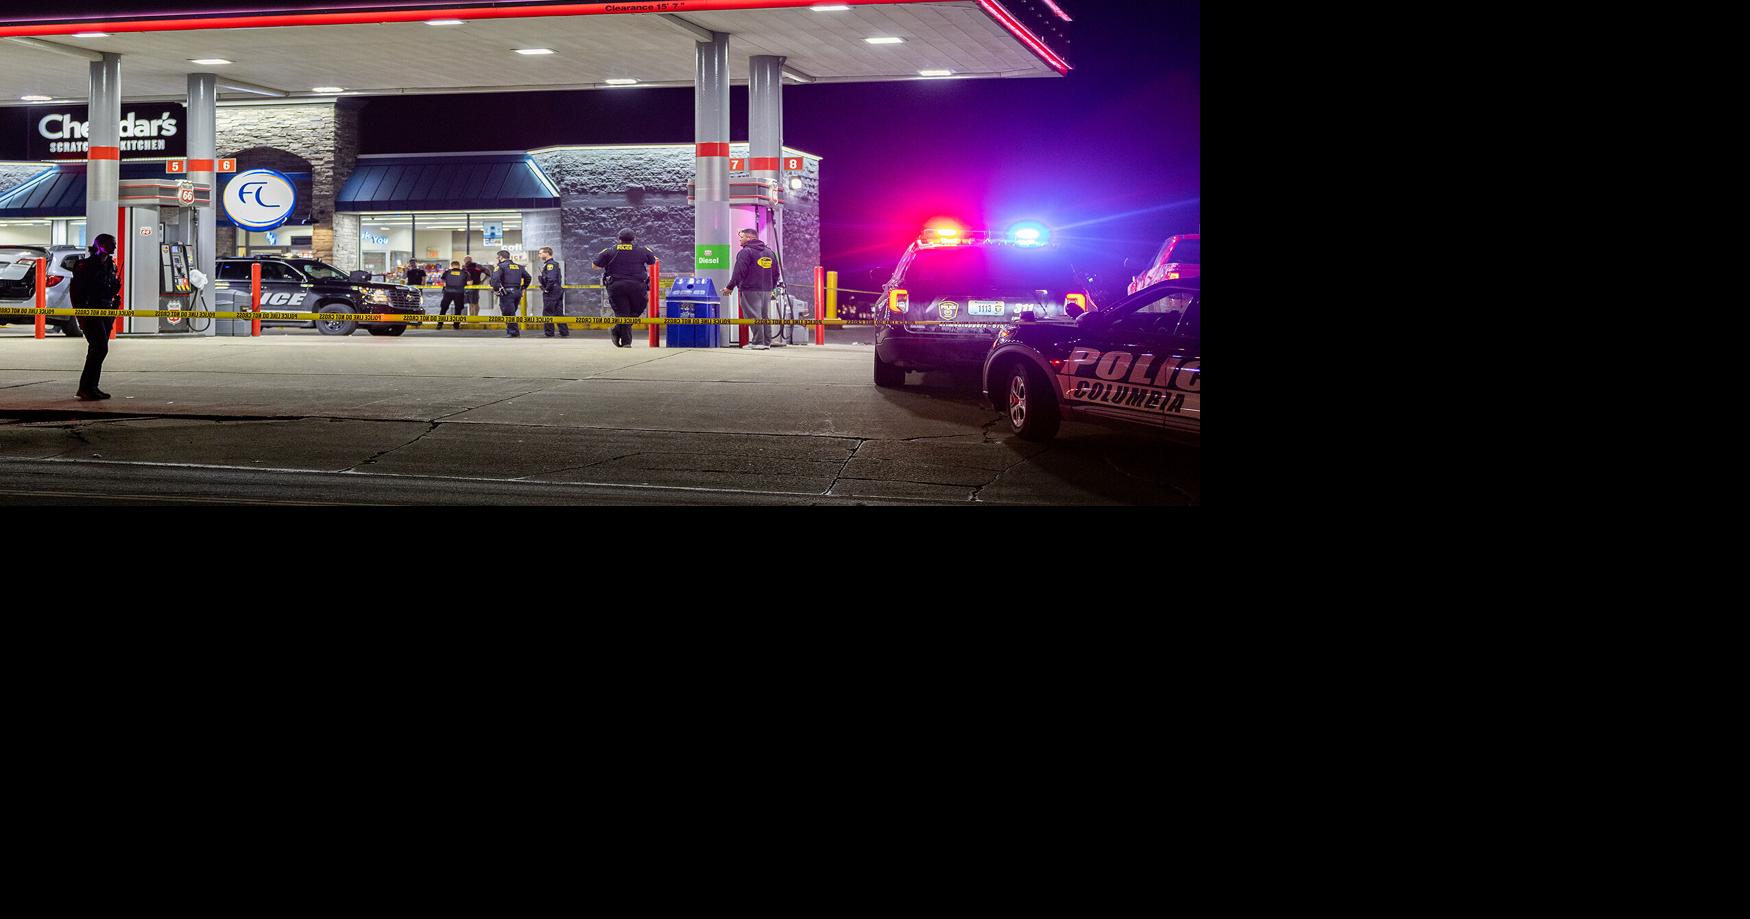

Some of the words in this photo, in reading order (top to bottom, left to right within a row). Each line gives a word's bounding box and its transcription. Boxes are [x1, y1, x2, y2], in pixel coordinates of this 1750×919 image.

[38, 112, 177, 139] Chedar's
[50, 141, 88, 153] SCRATC
[120, 140, 166, 151] KITCHEN
[172, 162, 178, 171] 5
[223, 161, 230, 170] 6
[732, 160, 738, 169] 7
[789, 160, 797, 169] 8
[183, 190, 192, 200] 66
[260, 293, 307, 305] ICE
[978, 305, 992, 313] 1113
[1060, 346, 1200, 391] POLIC
[1074, 380, 1185, 413] COLUMBIA
